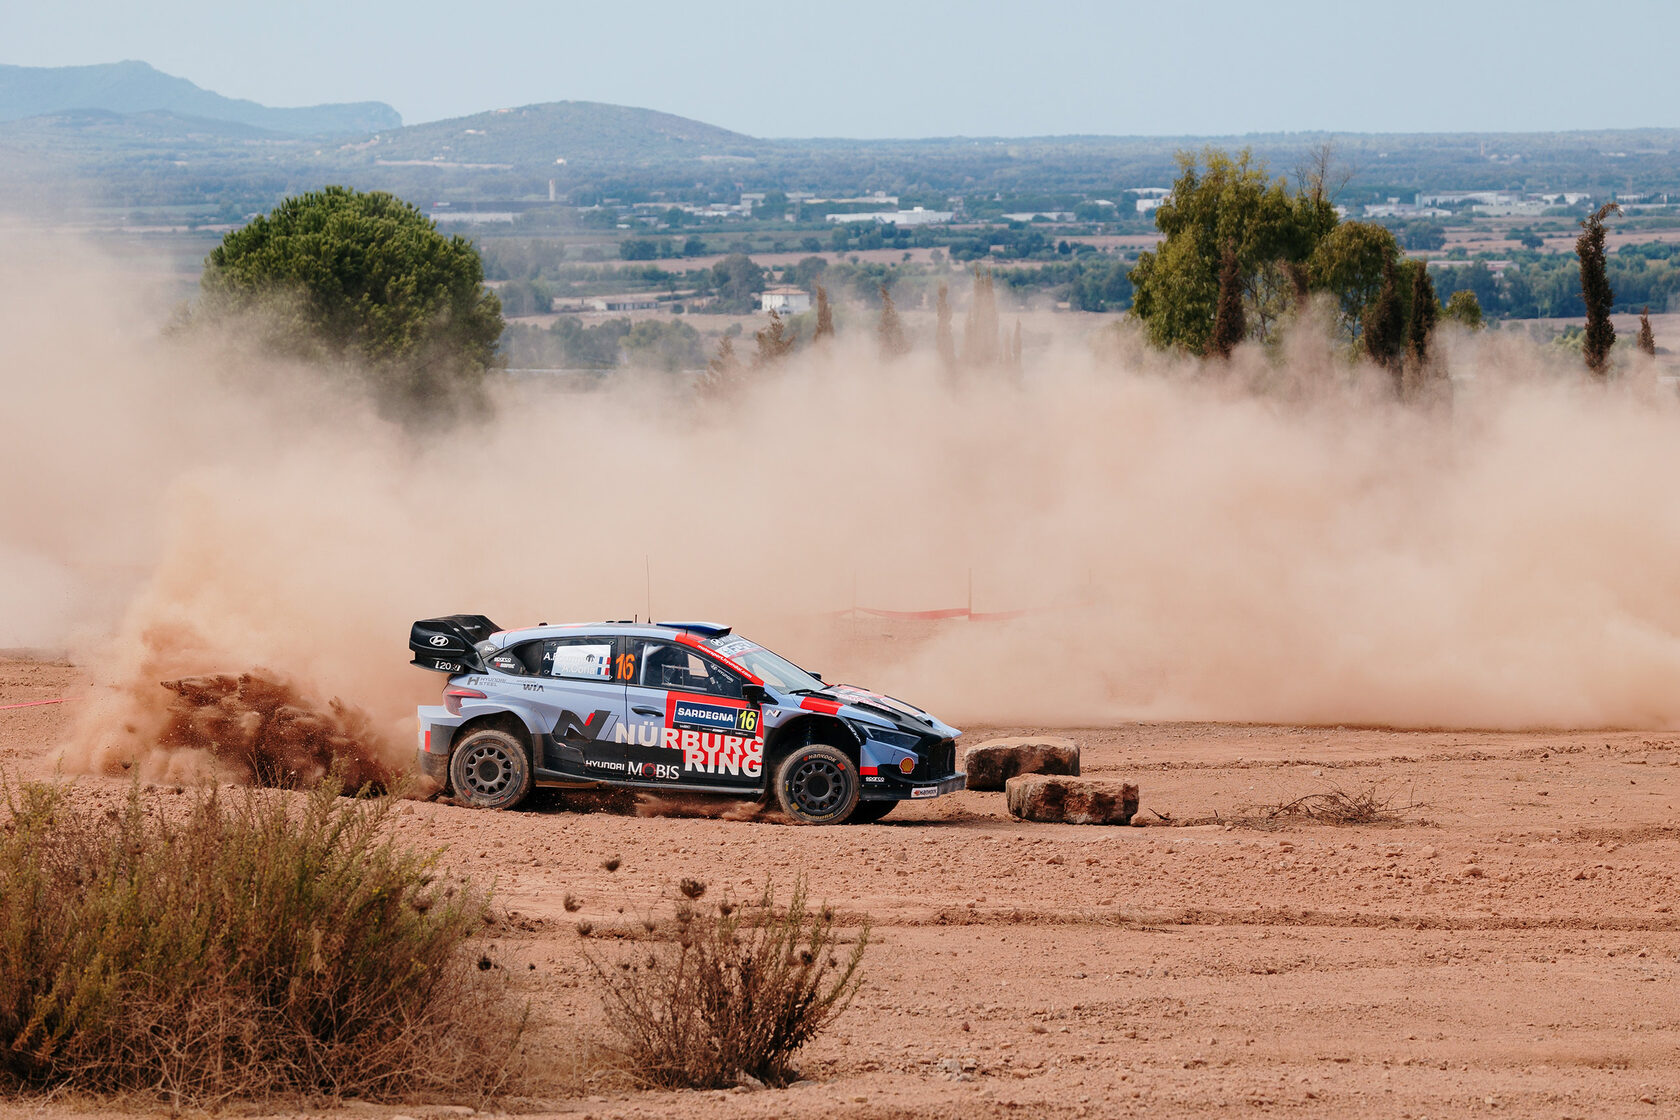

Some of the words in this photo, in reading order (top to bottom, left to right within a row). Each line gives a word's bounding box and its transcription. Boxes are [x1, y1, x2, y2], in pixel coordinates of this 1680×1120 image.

[615, 653, 636, 681] 16
[677, 707, 735, 723] SARDEGNA
[739, 710, 757, 731] 16
[615, 721, 764, 757] NÜRBURG
[584, 760, 626, 771] HYUNDAI
[627, 761, 680, 780] MOBIS
[684, 749, 763, 778] RING
